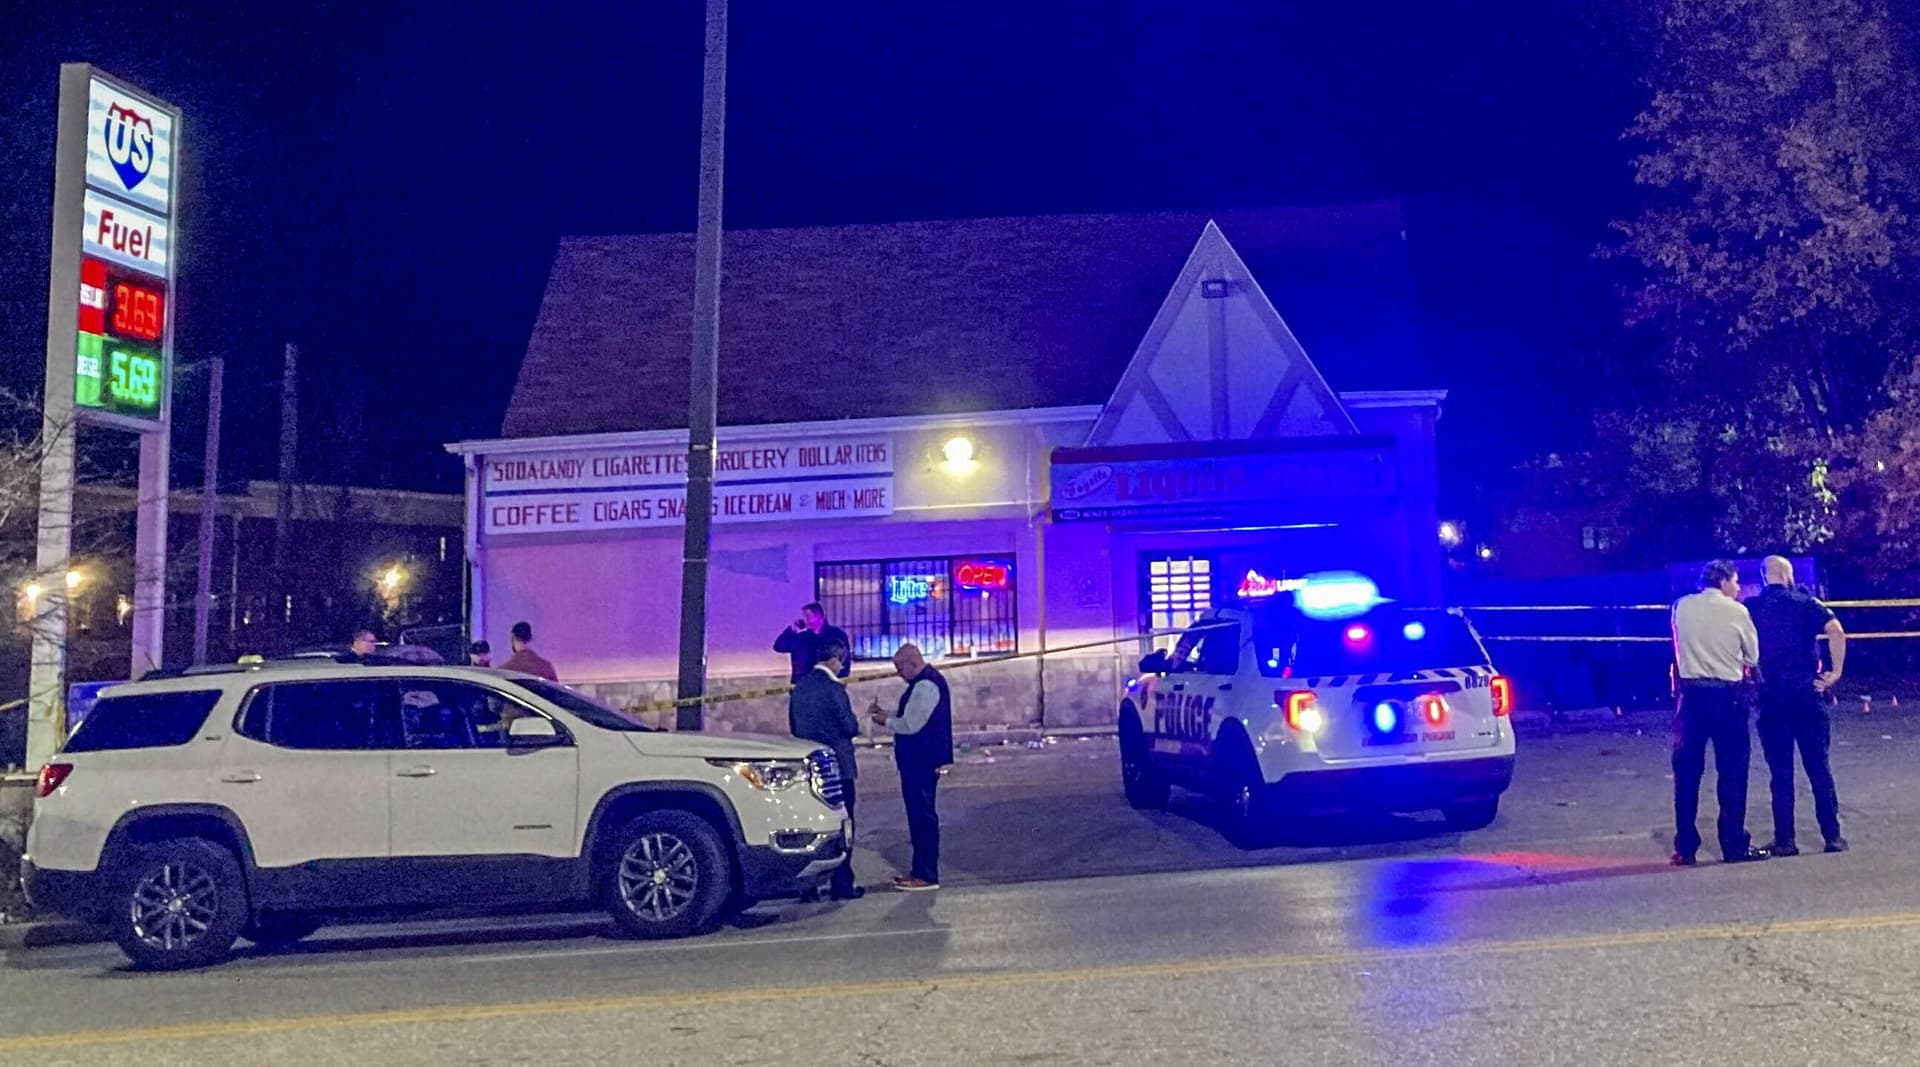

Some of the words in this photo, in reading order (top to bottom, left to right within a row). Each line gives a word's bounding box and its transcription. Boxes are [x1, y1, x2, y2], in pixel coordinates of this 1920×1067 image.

[107, 109, 153, 173] US
[97, 209, 152, 259] Fuel
[111, 350, 156, 406] 5.69
[799, 445, 852, 467] DOLLAR
[856, 442, 886, 464] ITEMS
[492, 503, 580, 527] COFFEE
[593, 499, 652, 522] CIGARS
[658, 495, 718, 519] SNAS
[724, 495, 746, 515] ICE
[749, 492, 791, 514] CREAM
[815, 489, 845, 511] MUCH
[854, 487, 886, 509] MORE
[889, 574, 929, 603] Lite
[958, 563, 1007, 587] OPEN
[1154, 691, 1215, 738] POLICE
